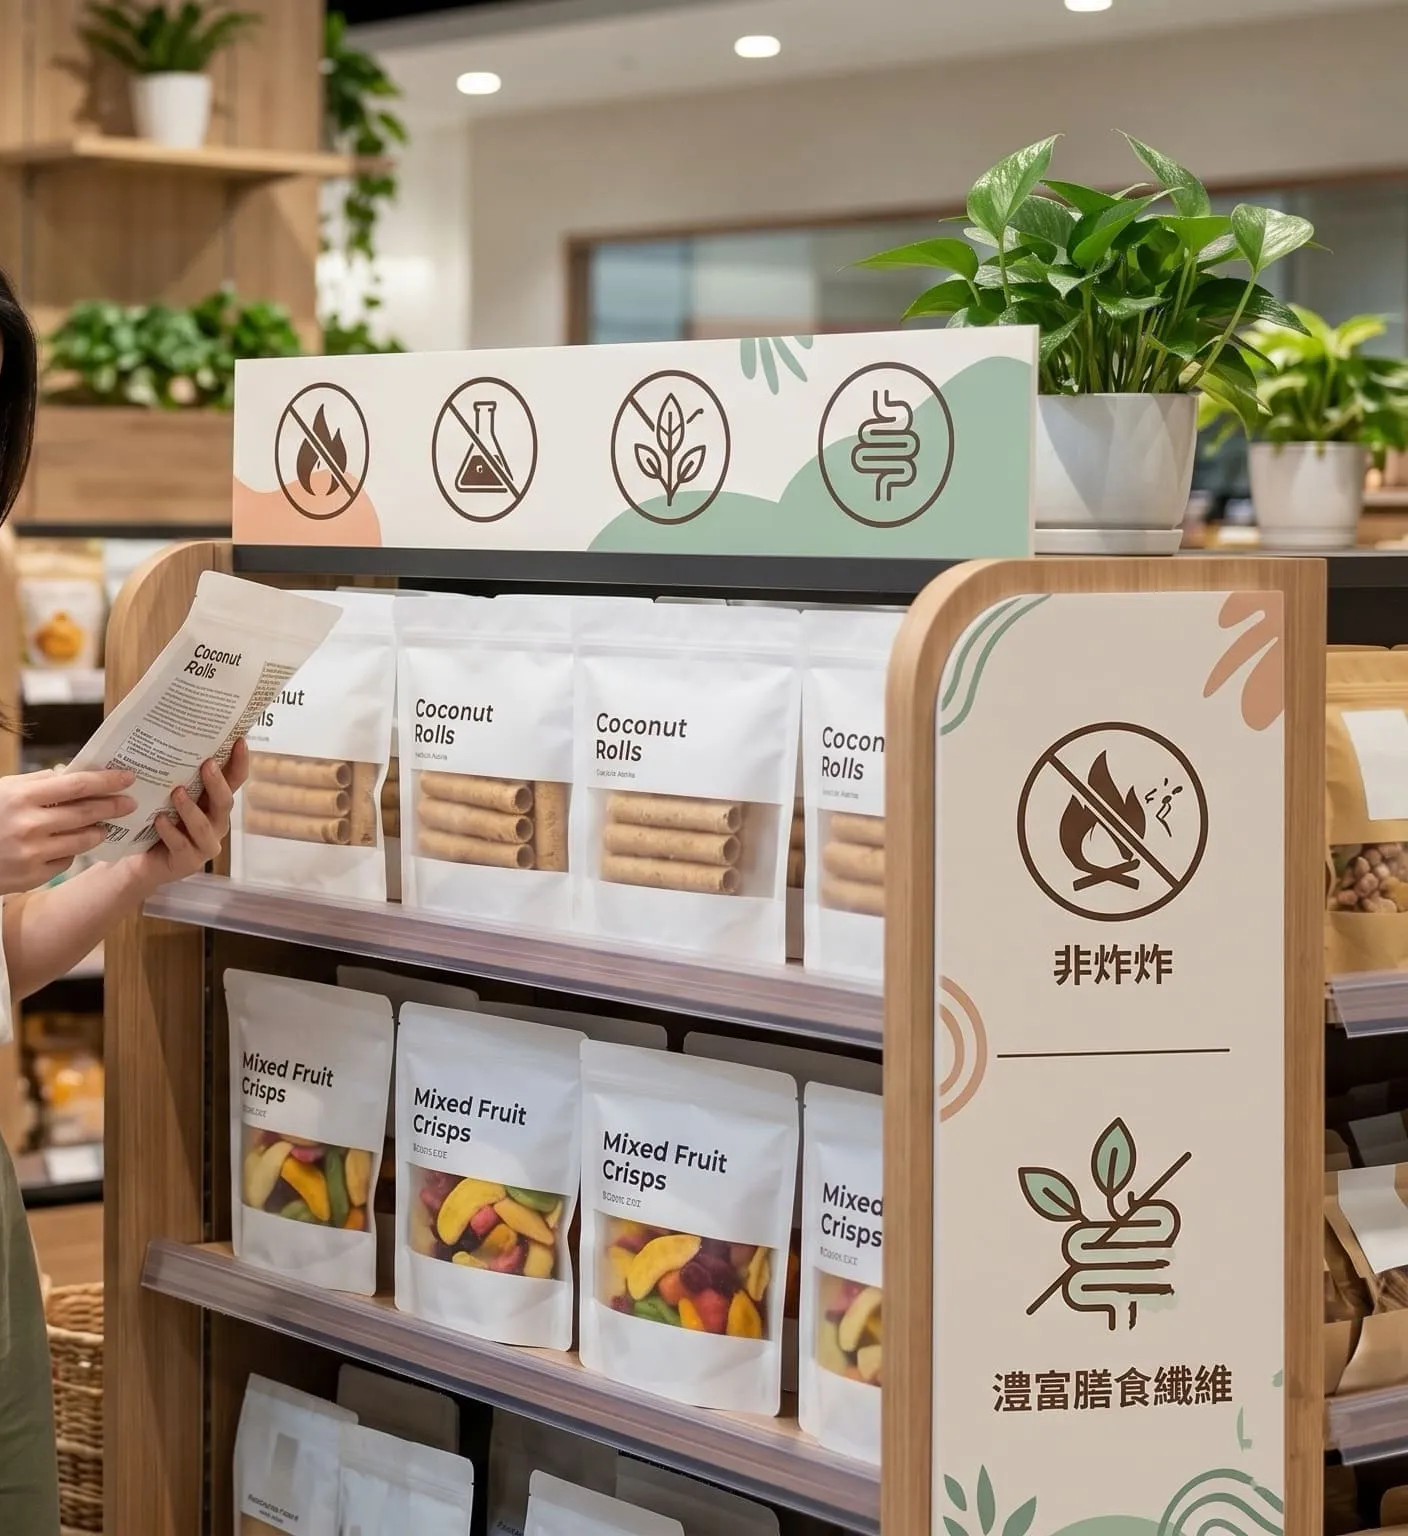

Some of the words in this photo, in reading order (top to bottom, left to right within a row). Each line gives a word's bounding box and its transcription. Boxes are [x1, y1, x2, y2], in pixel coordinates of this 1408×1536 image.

[184, 660, 217, 679] Rolls
[194, 644, 242, 666] Coconut
[415, 698, 494, 723] Coconut
[596, 712, 688, 738] Coconut
[415, 723, 455, 745] Rolls
[596, 739, 642, 762] Rolls
[821, 755, 864, 780] Rolls
[1053, 943, 1173, 986] 非炸炸
[242, 1051, 289, 1078] Mixed
[292, 1062, 334, 1088] Fruit
[242, 1076, 286, 1104] Crisps
[414, 1087, 473, 1116] Mixed
[478, 1099, 527, 1126] Fruit
[413, 1114, 472, 1145] Crisps
[603, 1131, 669, 1162] Mixed
[674, 1144, 727, 1173] Fruit
[603, 1159, 667, 1192] Crisps
[822, 1182, 884, 1217] Mixed
[821, 1213, 883, 1248] Crisps
[992, 1364, 1233, 1413] 澧富膳食纖維
